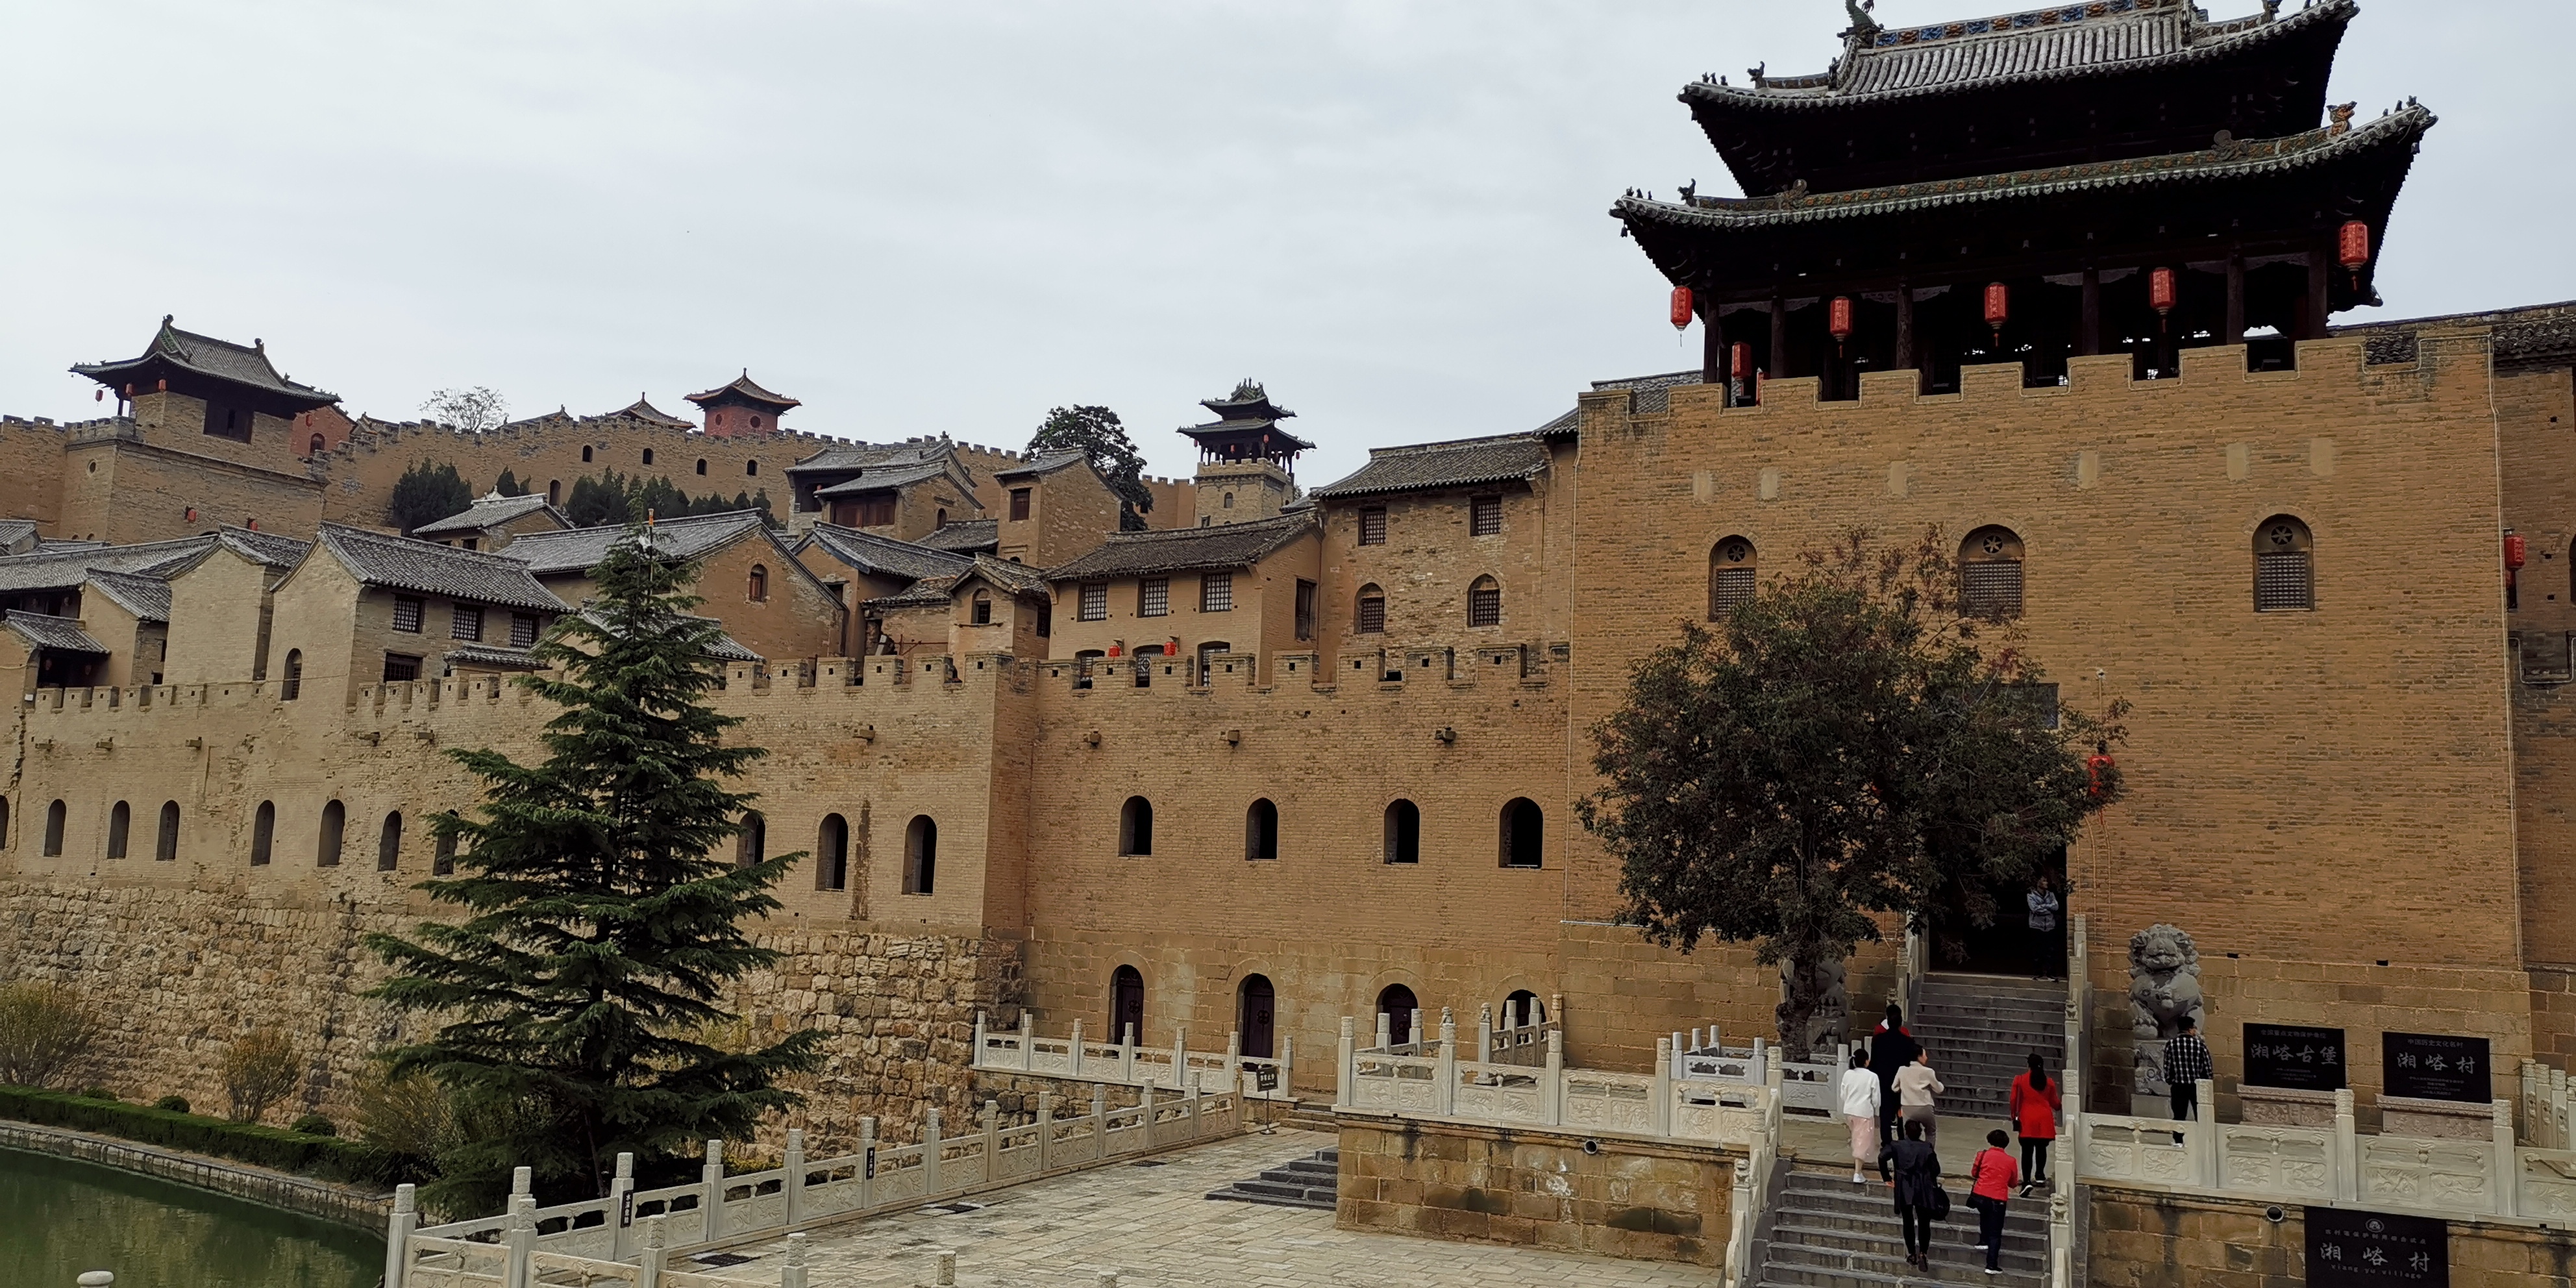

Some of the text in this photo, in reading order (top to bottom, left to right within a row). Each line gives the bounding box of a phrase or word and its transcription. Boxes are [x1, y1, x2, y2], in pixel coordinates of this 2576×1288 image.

[2250, 1043, 2338, 1065] 湘峪古堡
[2407, 1039, 2464, 1048] 中国历史文化名村
[2397, 1052, 2475, 1074] 湘峪村
[2320, 1243, 2430, 1272] 湘峪村
